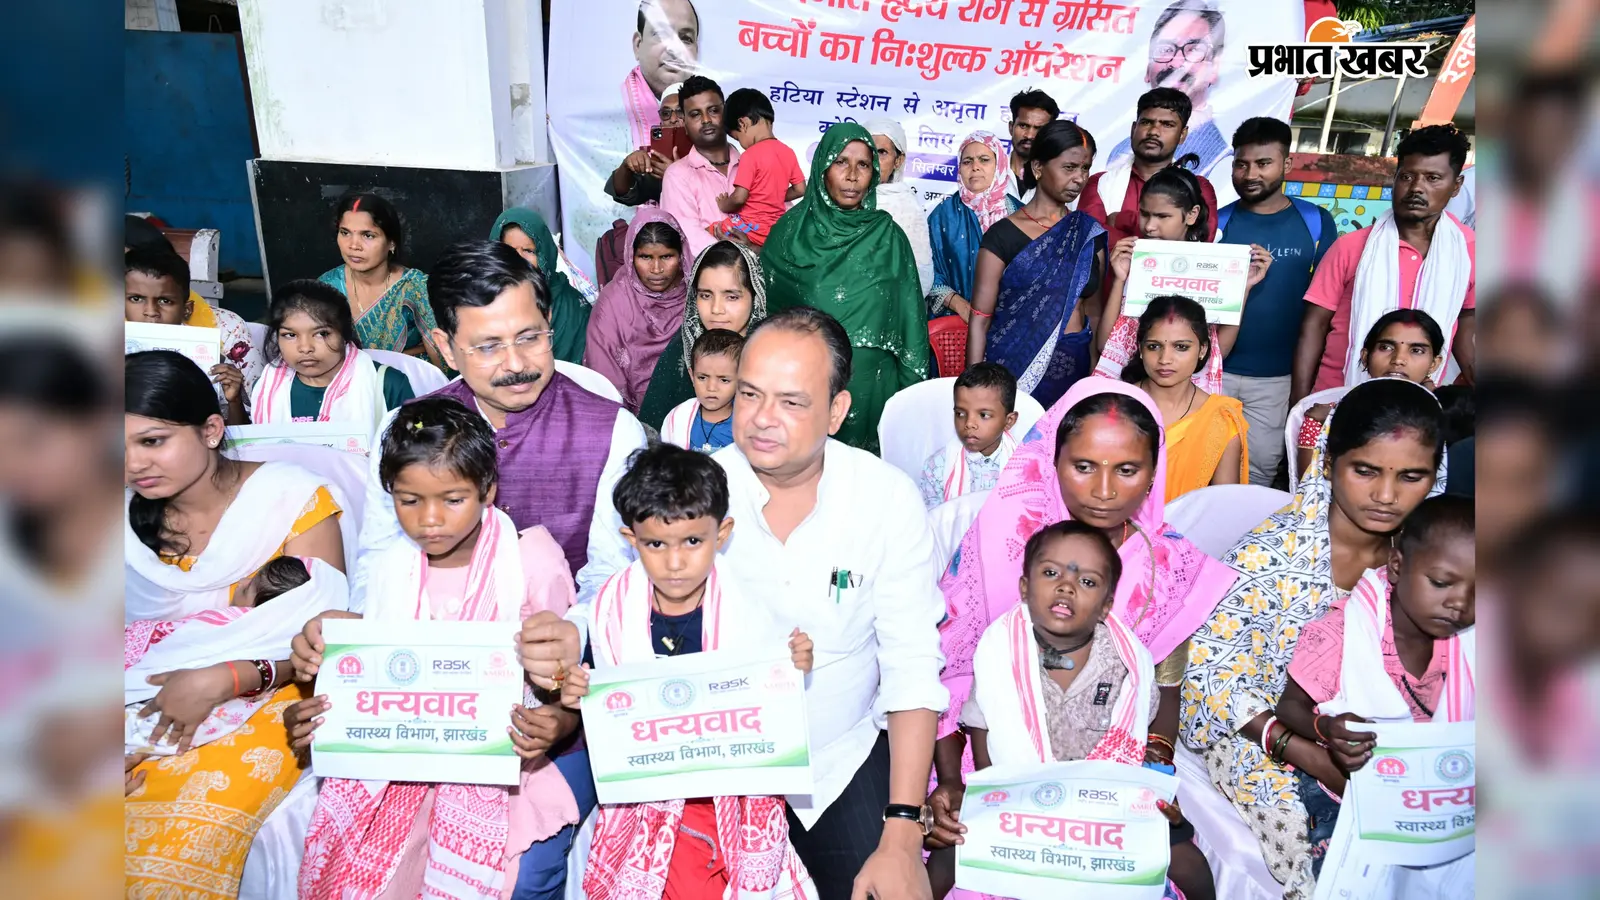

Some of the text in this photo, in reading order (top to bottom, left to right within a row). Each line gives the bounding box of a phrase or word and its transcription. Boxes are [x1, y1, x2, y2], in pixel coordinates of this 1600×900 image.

[1018, 0, 1050, 28] स
[738, 17, 1126, 83] बच्चों का निःशुल्क ऑपरेशन
[769, 80, 824, 105] हटिया
[836, 86, 892, 111] स्टेशन
[903, 92, 920, 114] से
[932, 99, 988, 124] अमृता
[918, 124, 955, 153] लिए
[912, 157, 956, 177] सितम्बर
[1151, 275, 1222, 293] धन्यवाद
[1197, 296, 1224, 304] झारखंड
[356, 690, 479, 720] धन्यवाद
[345, 724, 488, 743] स्वास्थ्य विभाग, झारखंड
[631, 706, 763, 742] धन्यवाद
[627, 738, 775, 767] स्वास्थ्य विभाग, झारखंड
[999, 811, 1126, 850] धन्यवाद
[1394, 819, 1447, 832] स्वास्थ्य
[990, 845, 1136, 872] स्वास्थ्य विभाग, झारखंड
